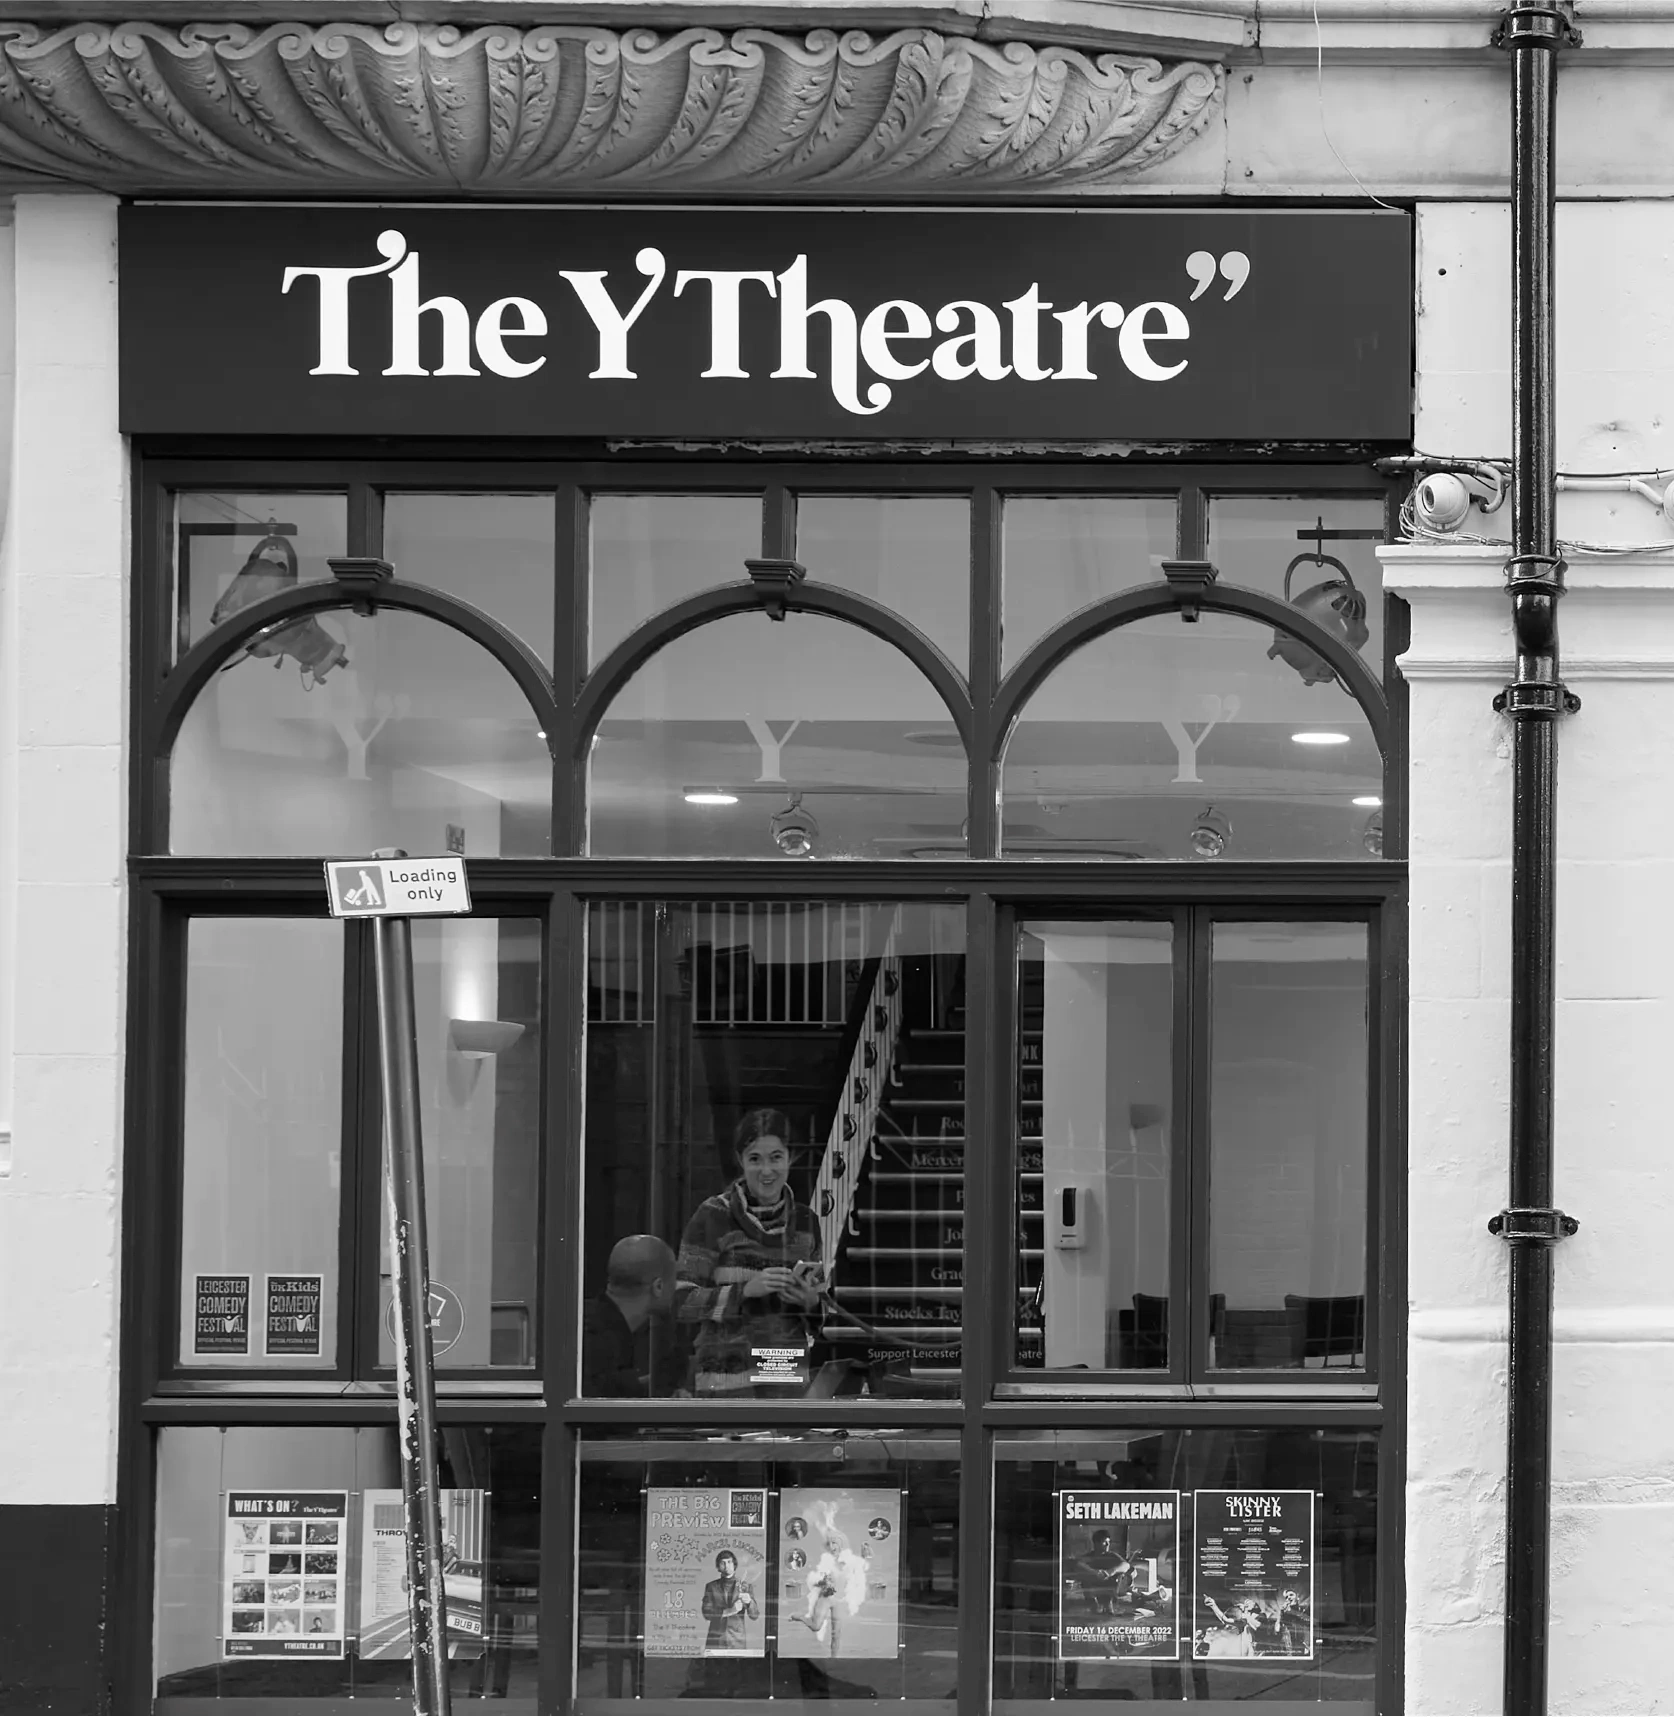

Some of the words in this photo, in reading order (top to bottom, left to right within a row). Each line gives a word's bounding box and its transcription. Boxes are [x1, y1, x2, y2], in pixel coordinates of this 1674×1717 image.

[282, 229, 548, 378] The
[558, 247, 666, 380] Y
[389, 868, 457, 883] Loading
[407, 886, 443, 901] only
[198, 1280, 247, 1293] LEICESTER
[198, 1297, 247, 1314] COMEDY
[270, 1296, 319, 1313] COMEDY
[868, 1350, 910, 1364] Support
[659, 1496, 689, 1510] THE
[1225, 1496, 1281, 1508] SKINNY
[1065, 1503, 1101, 1519] SETH
[1103, 1503, 1174, 1519] LAKEMAN
[1230, 1506, 1283, 1517] LISTER
[664, 1589, 685, 1609] 18
[1066, 1626, 1096, 1635] FRIDAY
[1097, 1626, 1107, 1635] 16
[1107, 1626, 1151, 1635] DECEMBER
[1152, 1626, 1173, 1635] 2022
[1071, 1634, 1109, 1642] LEICESTER
[1110, 1634, 1125, 1642] THE
[1134, 1634, 1168, 1642] THEATRE
